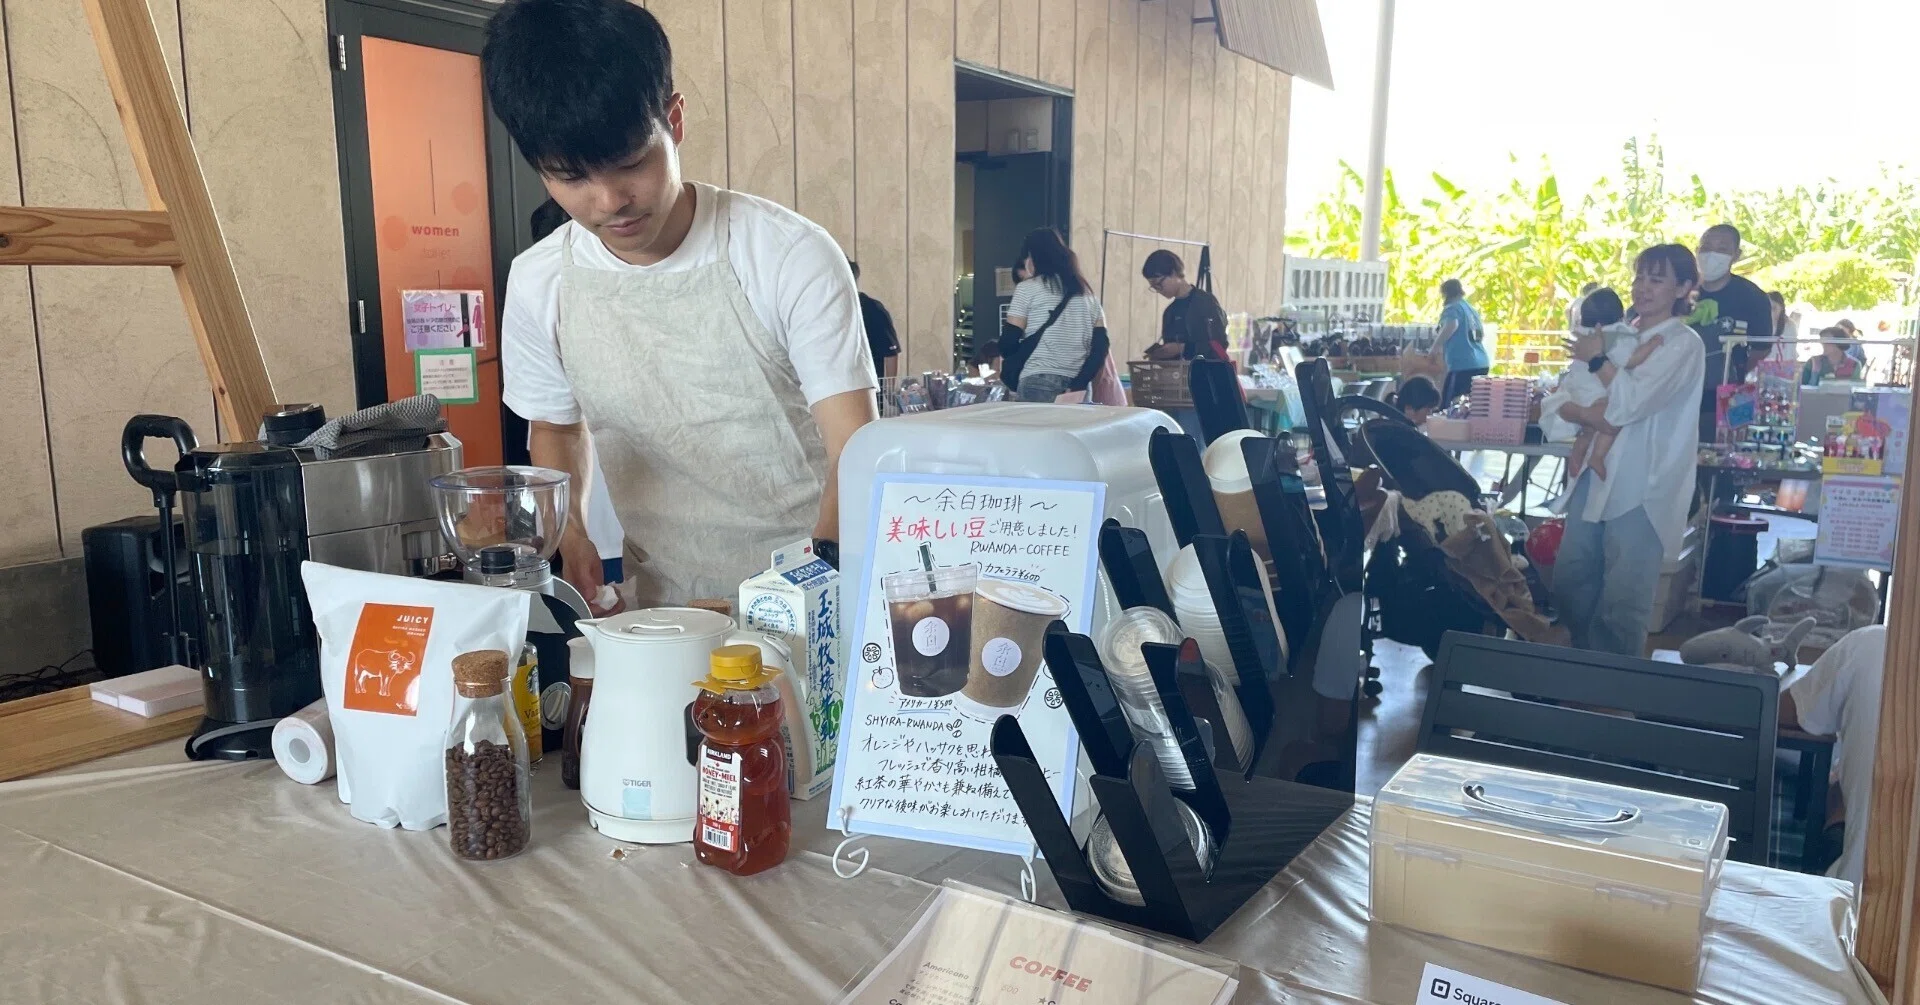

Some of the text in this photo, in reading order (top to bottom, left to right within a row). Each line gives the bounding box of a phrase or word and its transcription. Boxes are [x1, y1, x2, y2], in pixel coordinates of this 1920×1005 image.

[412, 225, 460, 237] women
[410, 324, 456, 335] ご注意ください
[970, 541, 1070, 556] RWANDA-COFFEE
[397, 614, 429, 624] JUICY
[865, 714, 944, 732] SHYIRA-RWANDA
[707, 748, 733, 760] KIRKLAND
[630, 779, 652, 788] TIGER
[923, 961, 969, 980] Americano
[1009, 956, 1093, 993] COFFEE
